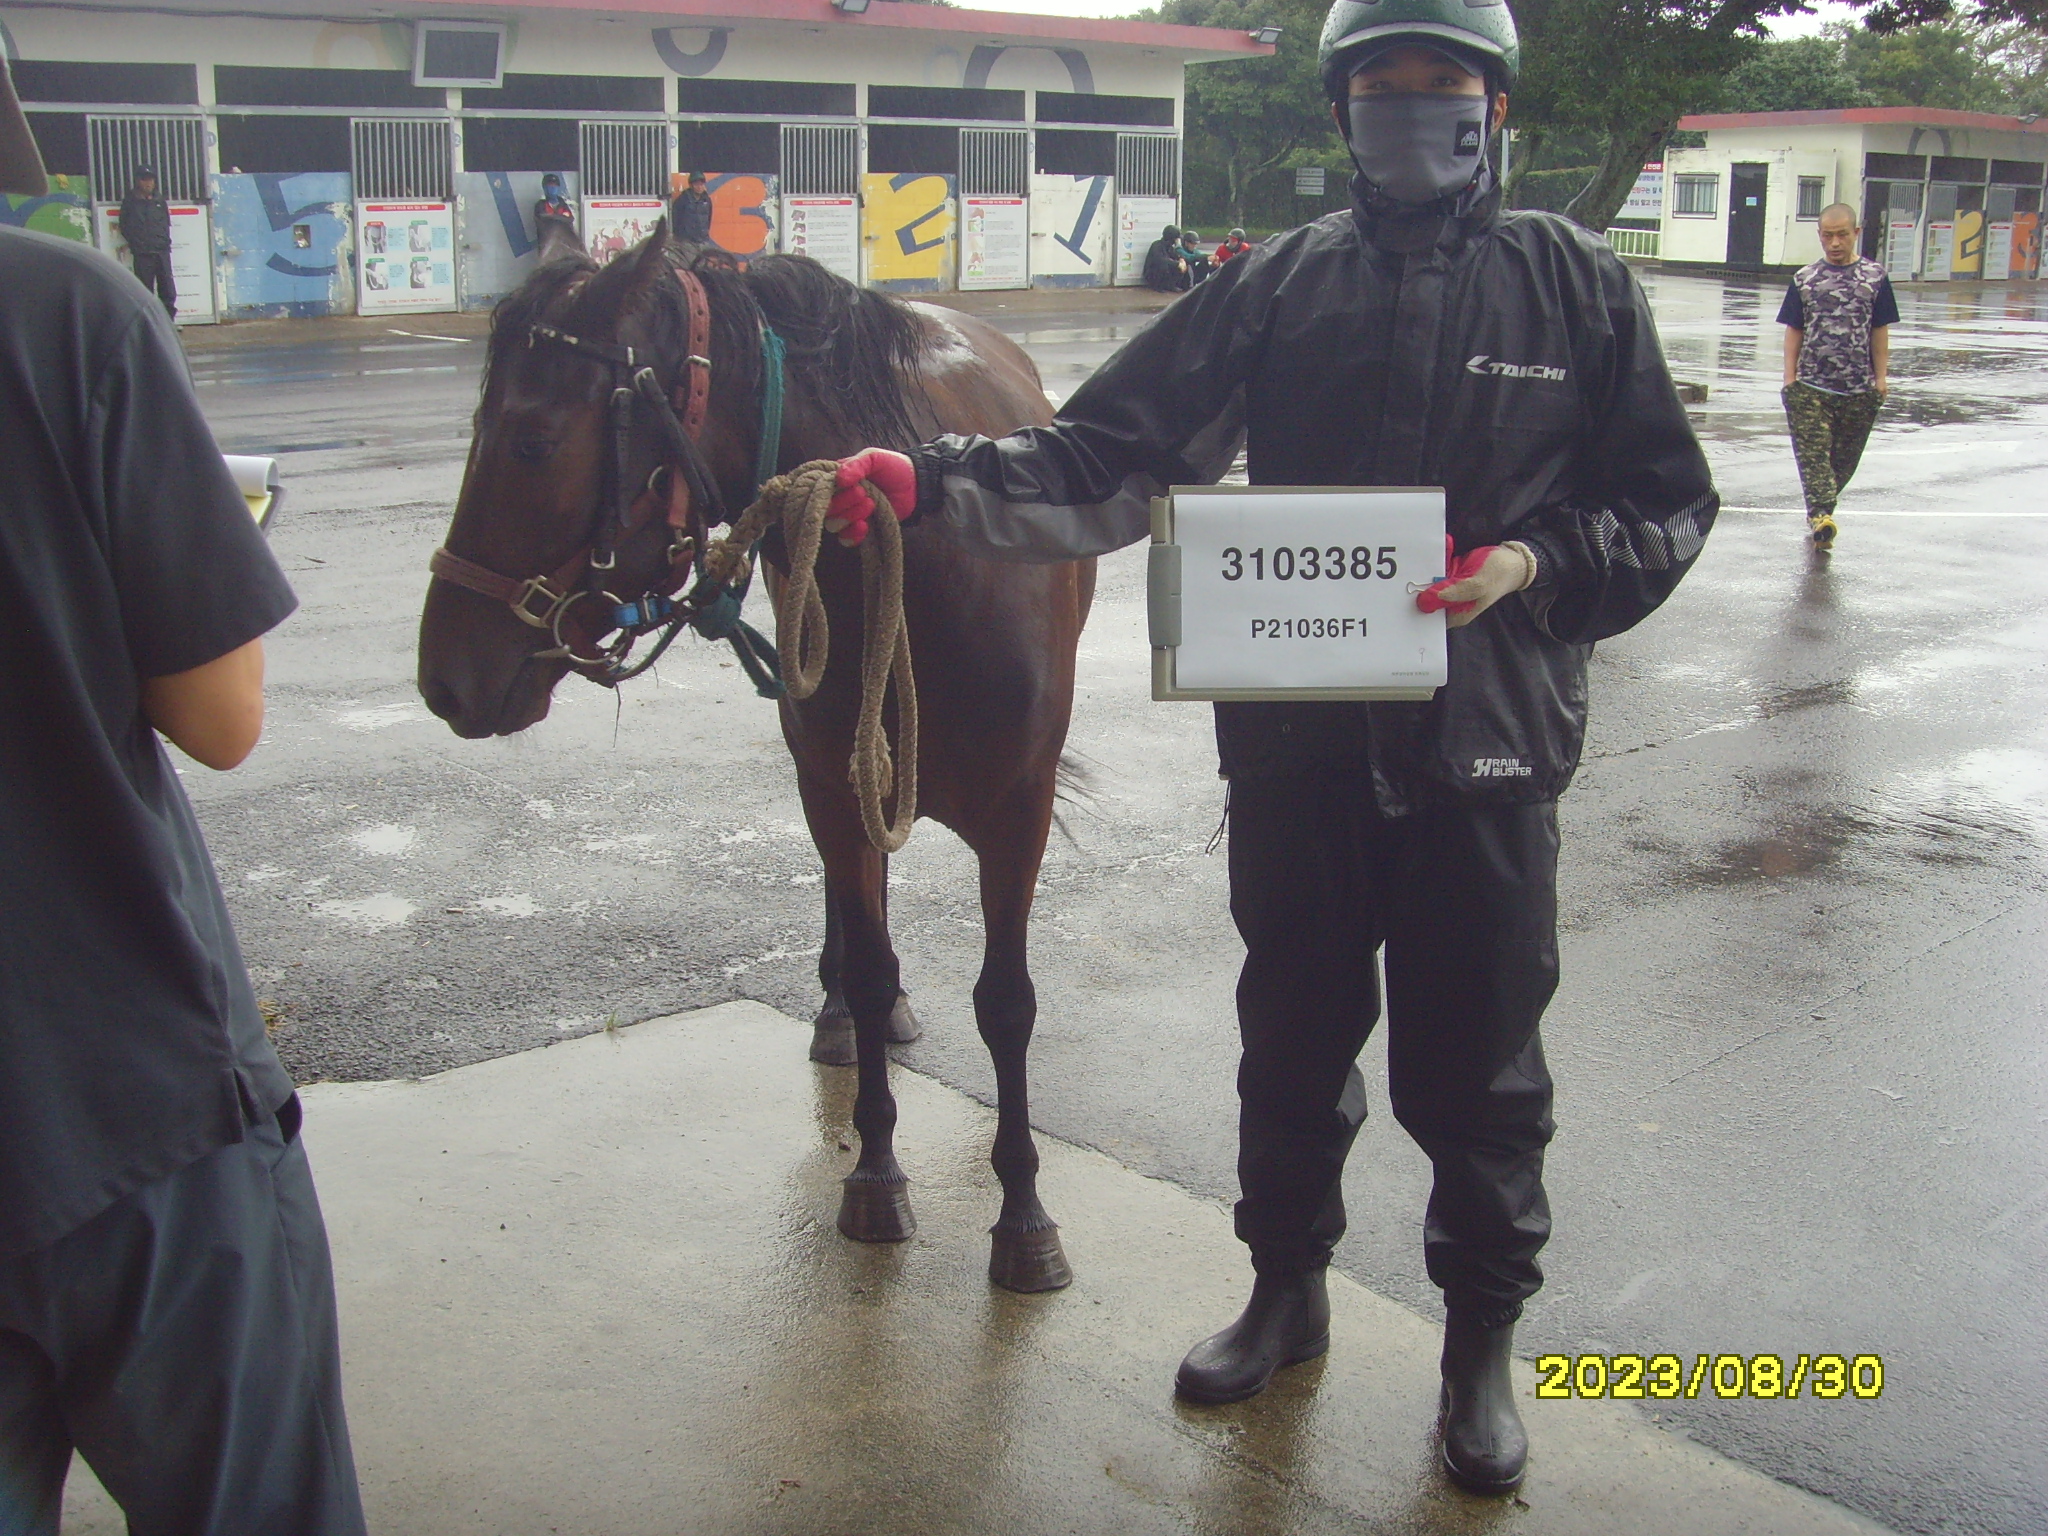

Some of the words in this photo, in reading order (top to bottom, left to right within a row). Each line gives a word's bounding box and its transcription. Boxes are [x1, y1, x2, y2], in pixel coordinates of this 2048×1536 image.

[253, 172, 353, 277] 5
[889, 173, 955, 257] 2
[1054, 175, 1109, 265] 1
[1960, 210, 1985, 260] 2
[1489, 362, 1566, 381] TAICHI
[1221, 546, 1397, 581] 3103385
[1251, 618, 1369, 638] P21036F1
[1492, 758, 1519, 767] RAIN
[1492, 767, 1532, 776] BUSTER
